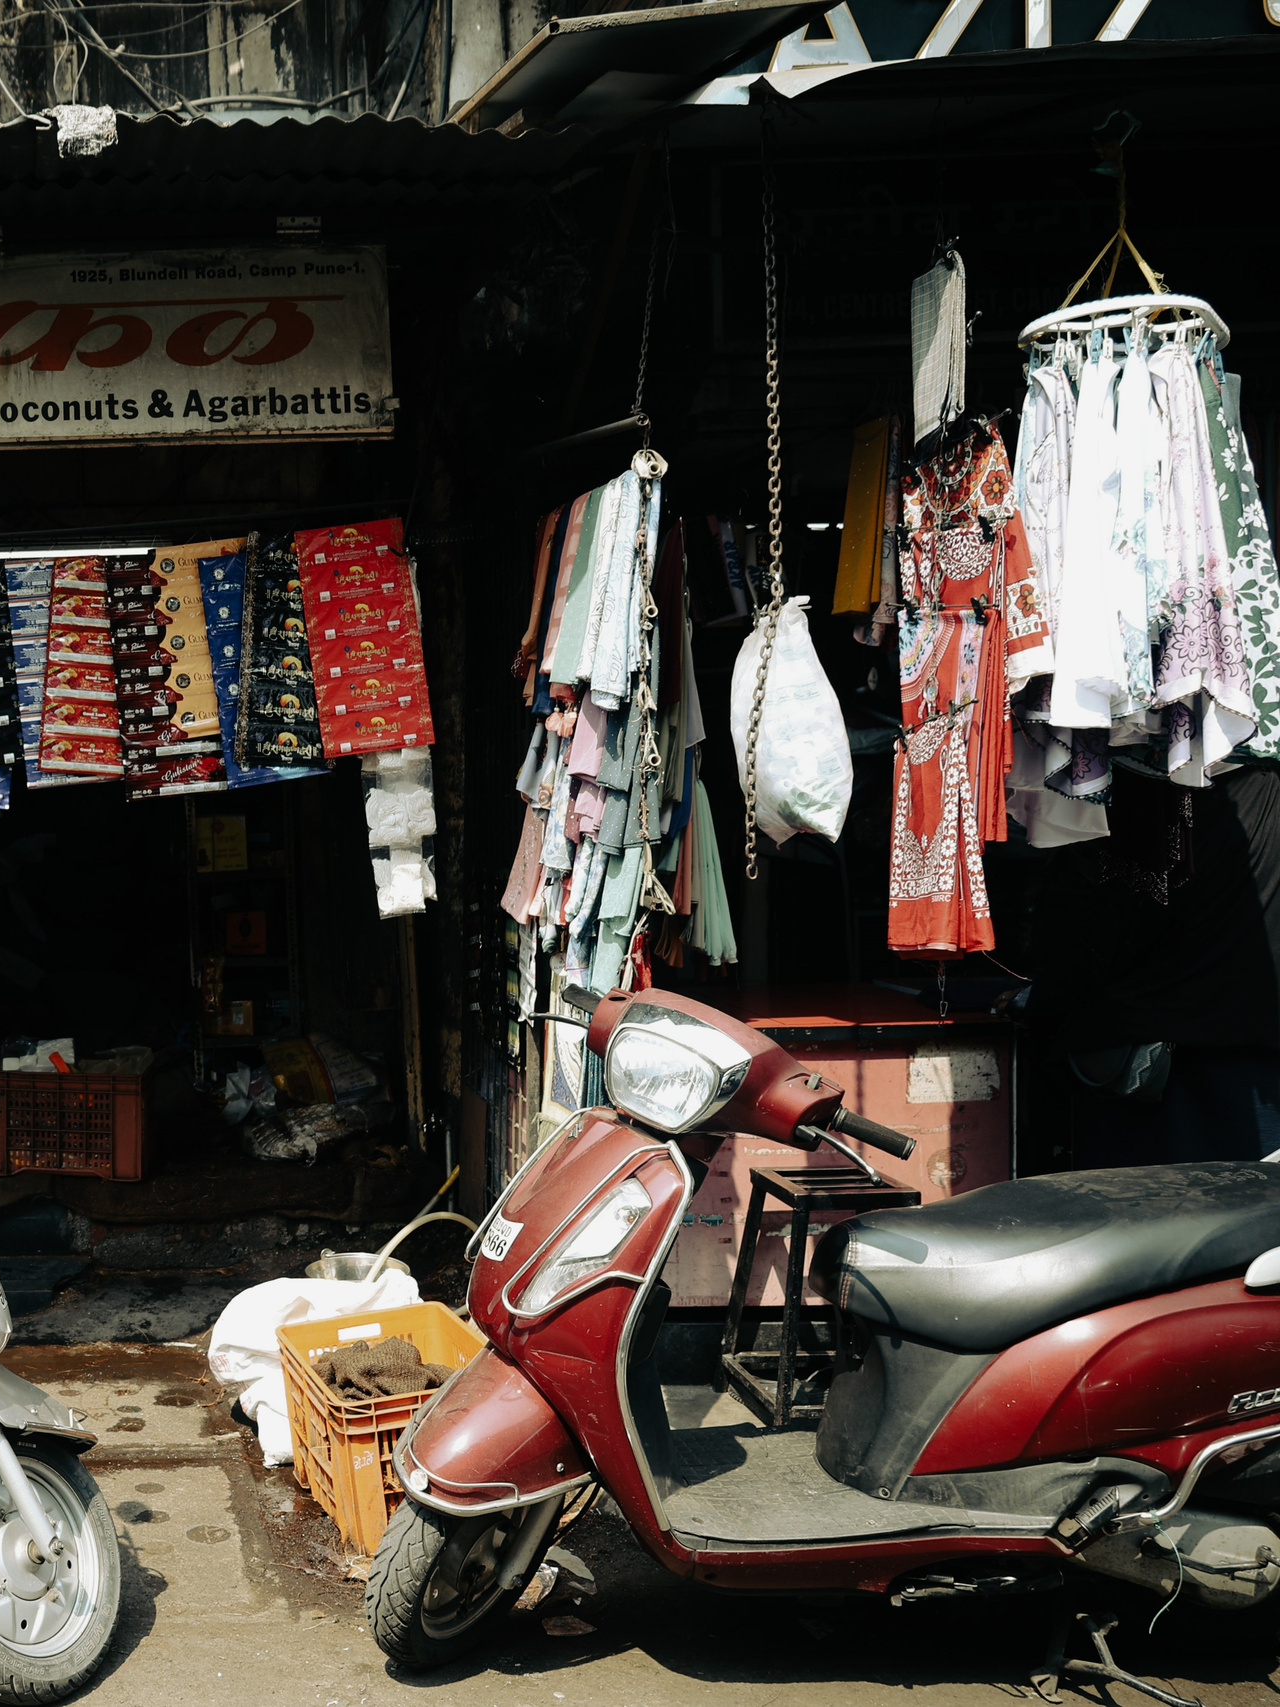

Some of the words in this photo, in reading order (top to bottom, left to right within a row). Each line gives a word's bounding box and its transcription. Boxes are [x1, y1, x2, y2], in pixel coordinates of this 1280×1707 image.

[69, 269, 113, 285] 1925,
[120, 267, 188, 282] Blundell
[195, 265, 242, 281] Road,
[249, 263, 297, 279] Camp
[304, 261, 365, 276] Pune-1.
[147, 389, 173, 419] &
[182, 385, 371, 422] Agarbattis
[161, 758, 201, 782] Gulistan
